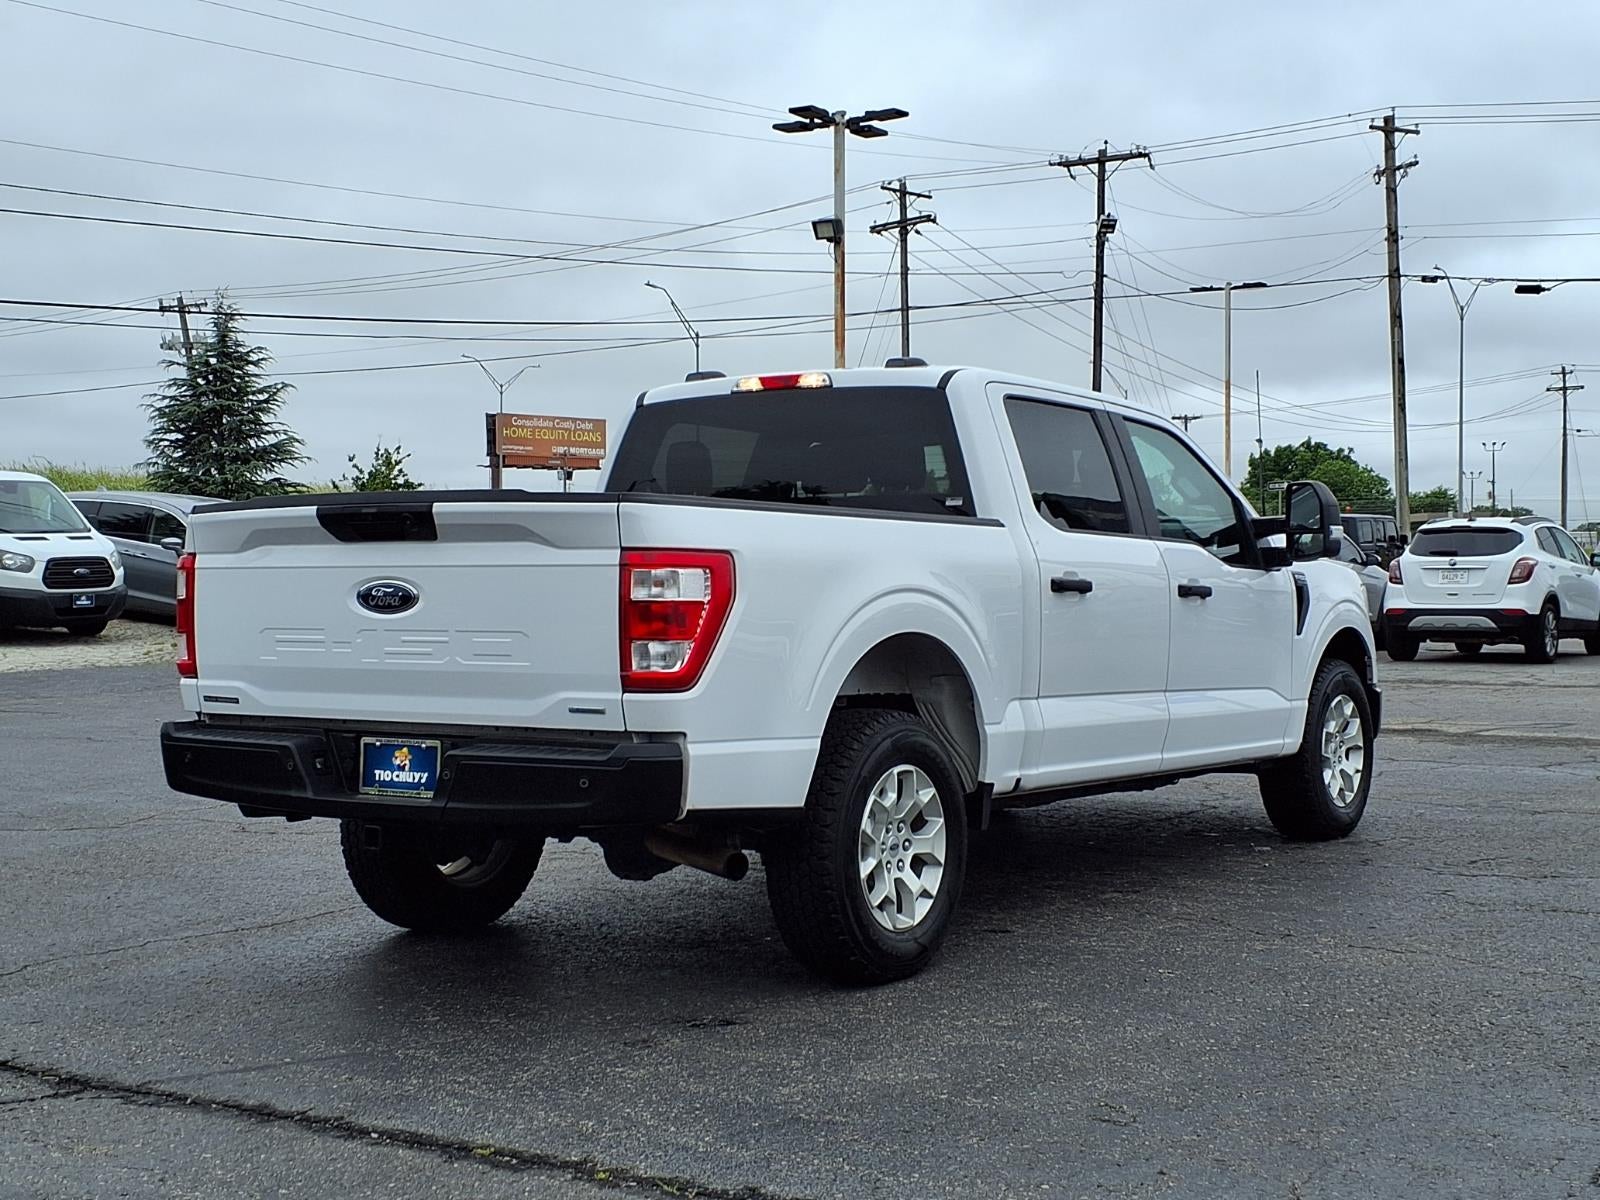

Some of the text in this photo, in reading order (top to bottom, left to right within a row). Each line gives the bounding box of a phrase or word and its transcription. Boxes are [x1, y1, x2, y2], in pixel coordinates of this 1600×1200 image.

[511, 417, 593, 431] Consolidate Costly Debt
[503, 427, 602, 442] HOME EQUITY LOANS
[569, 446, 605, 456] MORTGAGE
[258, 626, 531, 666] F-150
[374, 769, 429, 784] TIO CHUY'S
